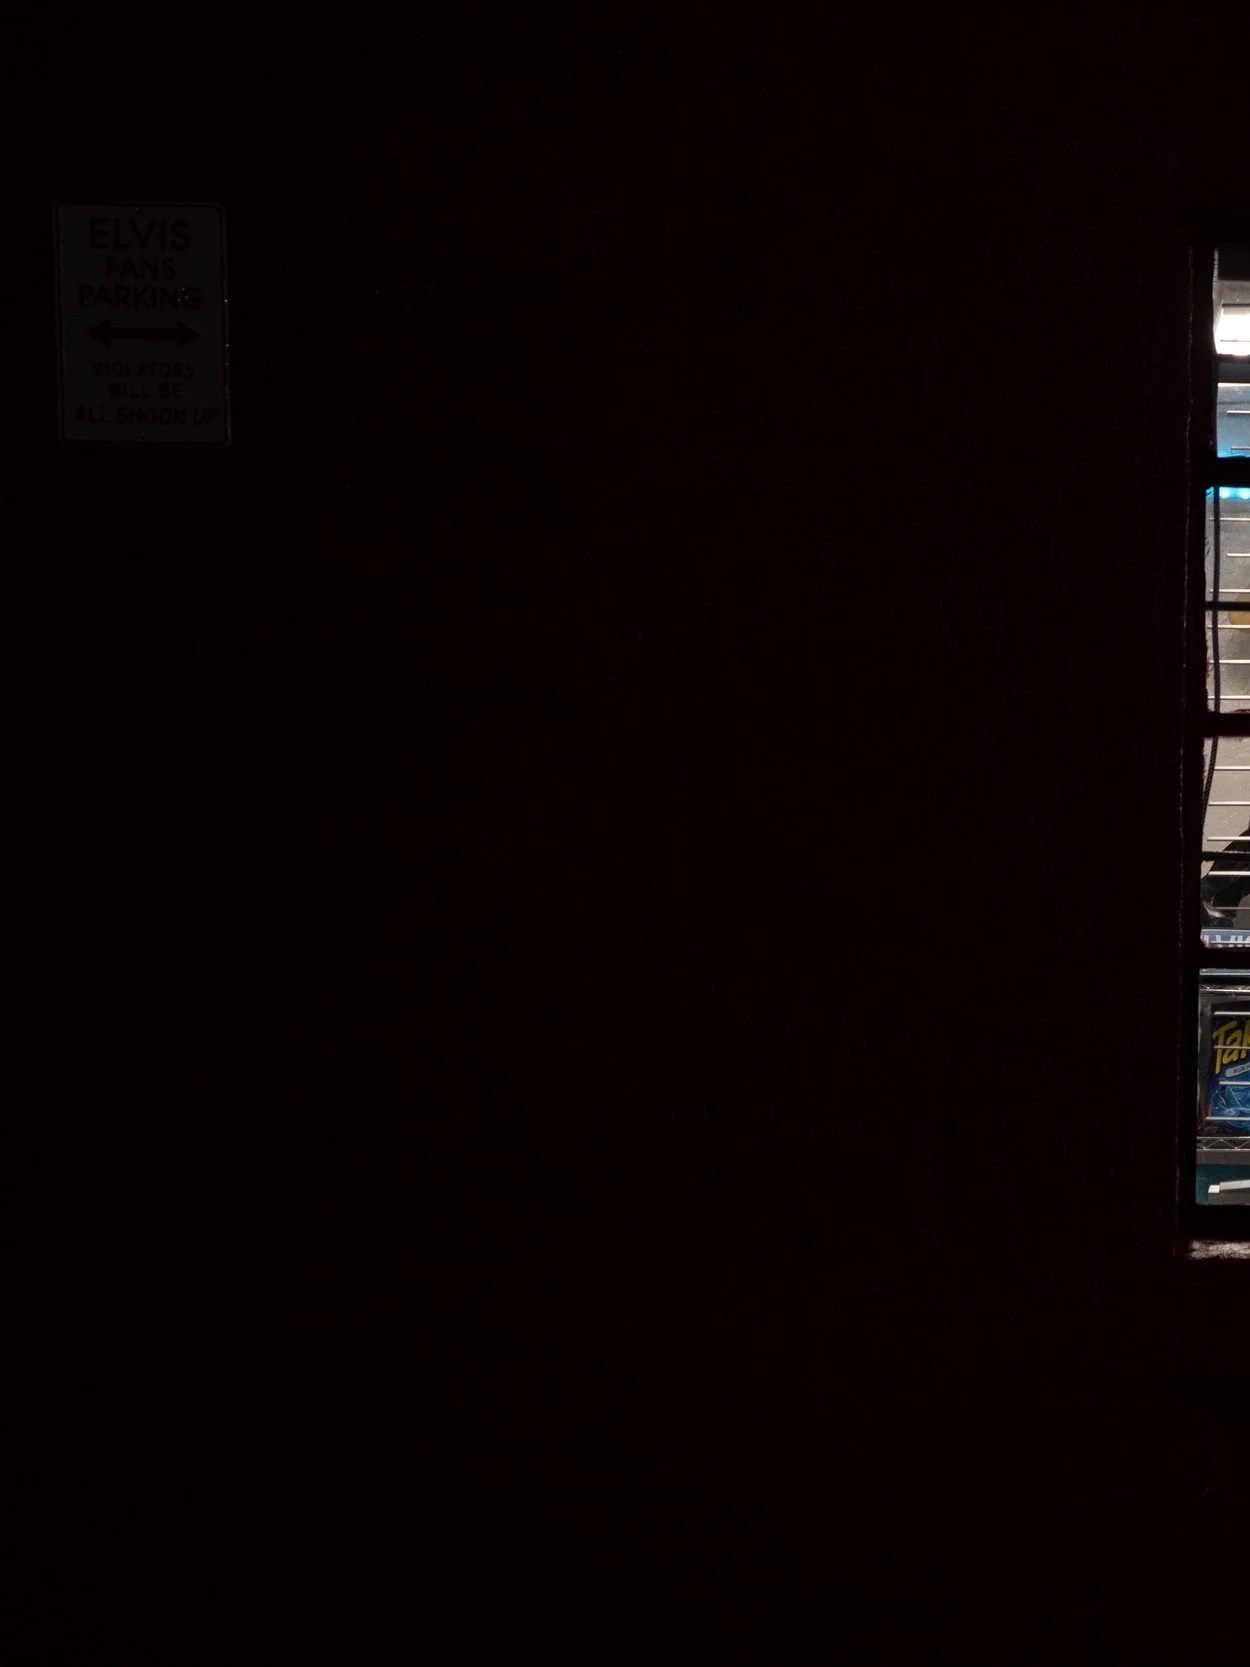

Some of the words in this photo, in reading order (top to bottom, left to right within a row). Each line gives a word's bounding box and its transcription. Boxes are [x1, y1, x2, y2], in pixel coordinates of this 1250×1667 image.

[89, 216, 192, 252] ELVIS
[106, 255, 176, 281] FANS
[78, 283, 205, 310] PARKING
[91, 360, 194, 379] VIOLATORS
[109, 382, 152, 399] WILL
[159, 382, 182, 399] BE
[74, 405, 108, 423] ALL
[115, 406, 187, 425] SHOOK
[193, 407, 221, 425] UP
